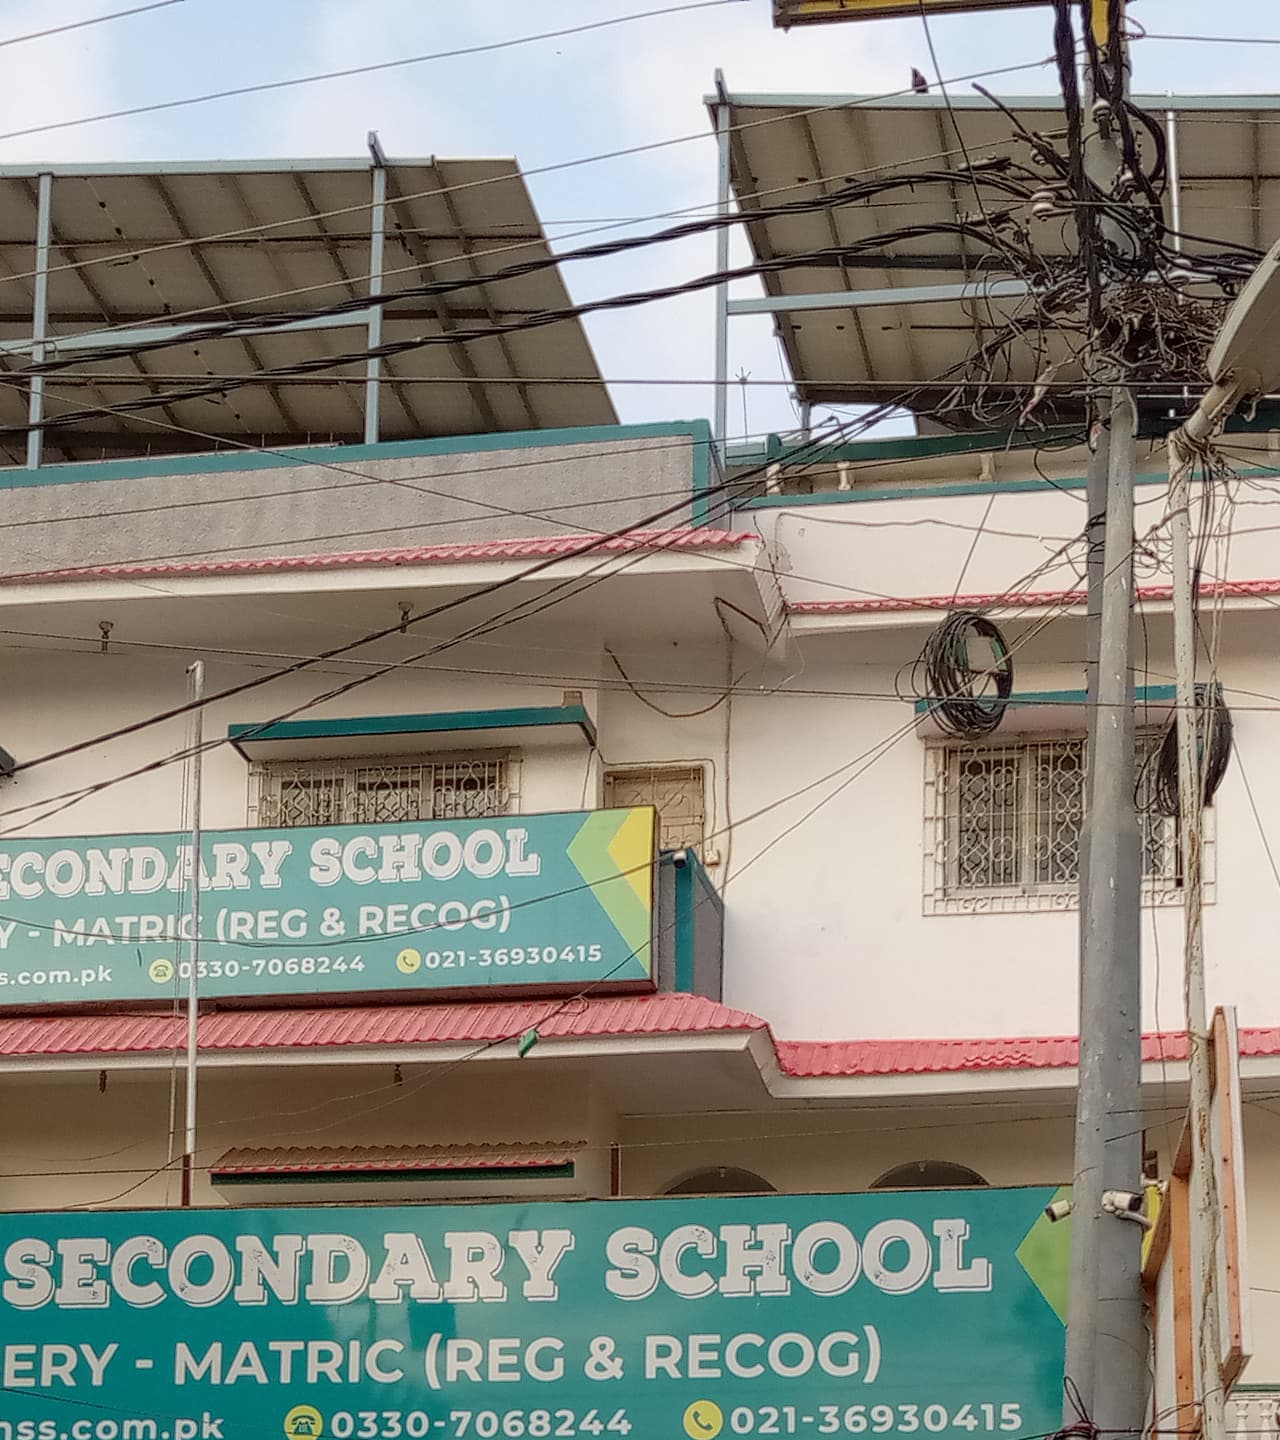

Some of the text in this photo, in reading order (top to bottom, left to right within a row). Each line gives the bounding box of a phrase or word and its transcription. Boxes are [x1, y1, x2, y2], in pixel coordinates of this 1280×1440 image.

[310, 828, 541, 887] SCHOOL
[53, 913, 203, 948] MATRIC
[216, 906, 307, 945] (REG
[319, 905, 347, 937] &
[359, 895, 512, 936] RECOG)
[178, 955, 366, 978] 0330-7068244
[424, 944, 603, 969] 021-36930415
[1, 1228, 574, 1310] SECONDARY
[606, 1218, 993, 1301] SCHOOL
[173, 1336, 404, 1386] MATRIC
[423, 1330, 565, 1390] (REG
[589, 1334, 626, 1382] &
[644, 1325, 882, 1383] RECOG)
[329, 1405, 633, 1440] 0330-7068244
[730, 1400, 1024, 1435] 021-36930415
